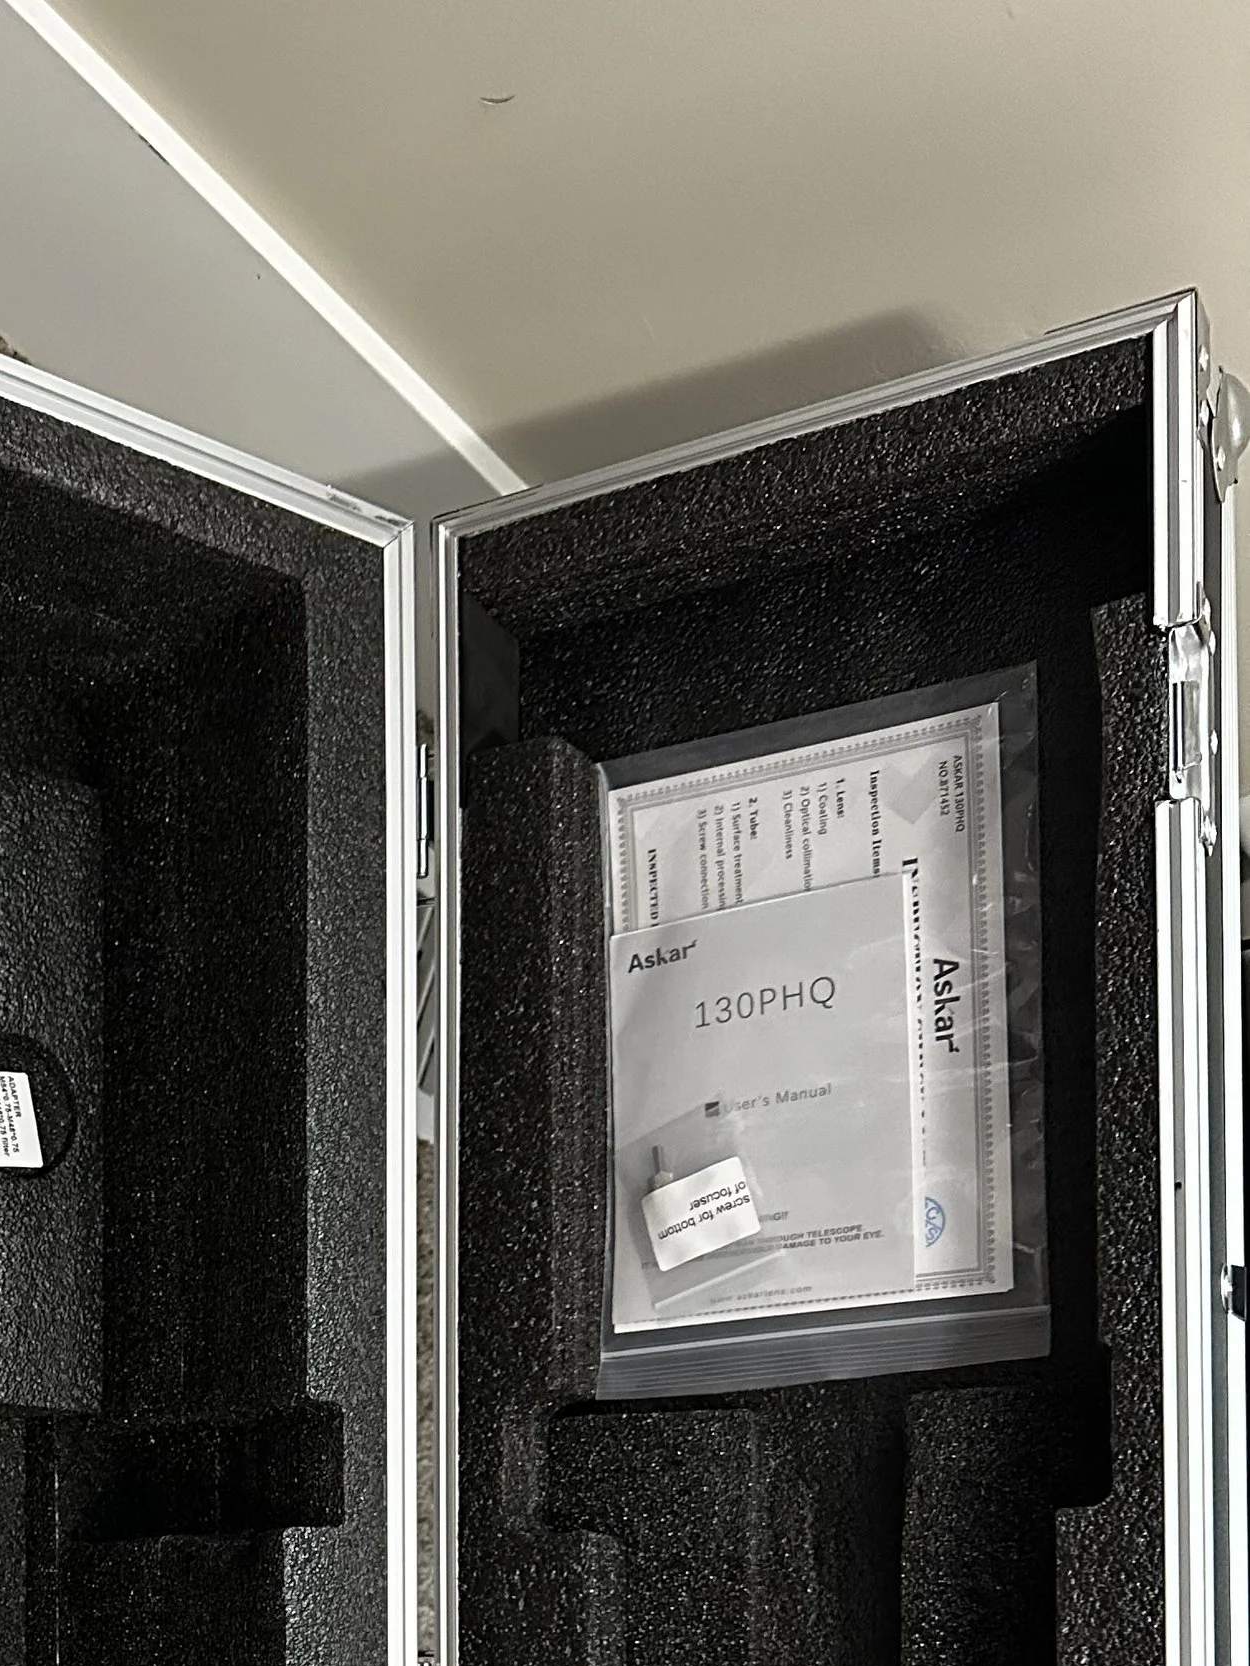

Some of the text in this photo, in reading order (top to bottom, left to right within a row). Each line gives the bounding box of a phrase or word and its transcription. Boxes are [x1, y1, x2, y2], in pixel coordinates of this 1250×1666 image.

[713, 804, 724, 816] 2)
[800, 785, 810, 797] 2)
[816, 781, 829, 835] 1) Coating
[836, 790, 846, 819] Lens:
[869, 769, 882, 836] Inspection
[953, 754, 966, 833] ASKAR 130PHQ
[714, 817, 726, 857] Internal
[749, 809, 760, 840] Tube:
[782, 789, 794, 859] 3) Cleanliness
[799, 798, 812, 836] Optical
[696, 808, 710, 910] 3) Screw connection
[730, 801, 744, 904] 1) Surface treatment
[627, 939, 698, 974] Askar
[695, 976, 836, 1029] 130PHQ
[933, 958, 961, 1053] Askar
[8, 1075, 22, 1118] ADAPTER
[775, 1082, 832, 1106] Manual
[1, 1137, 11, 1157] filter
[689, 1180, 747, 1211] of focuser
[657, 1194, 751, 1240] screw for bottom
[819, 1237, 832, 1246] TO
[834, 1232, 861, 1244] YOUR
